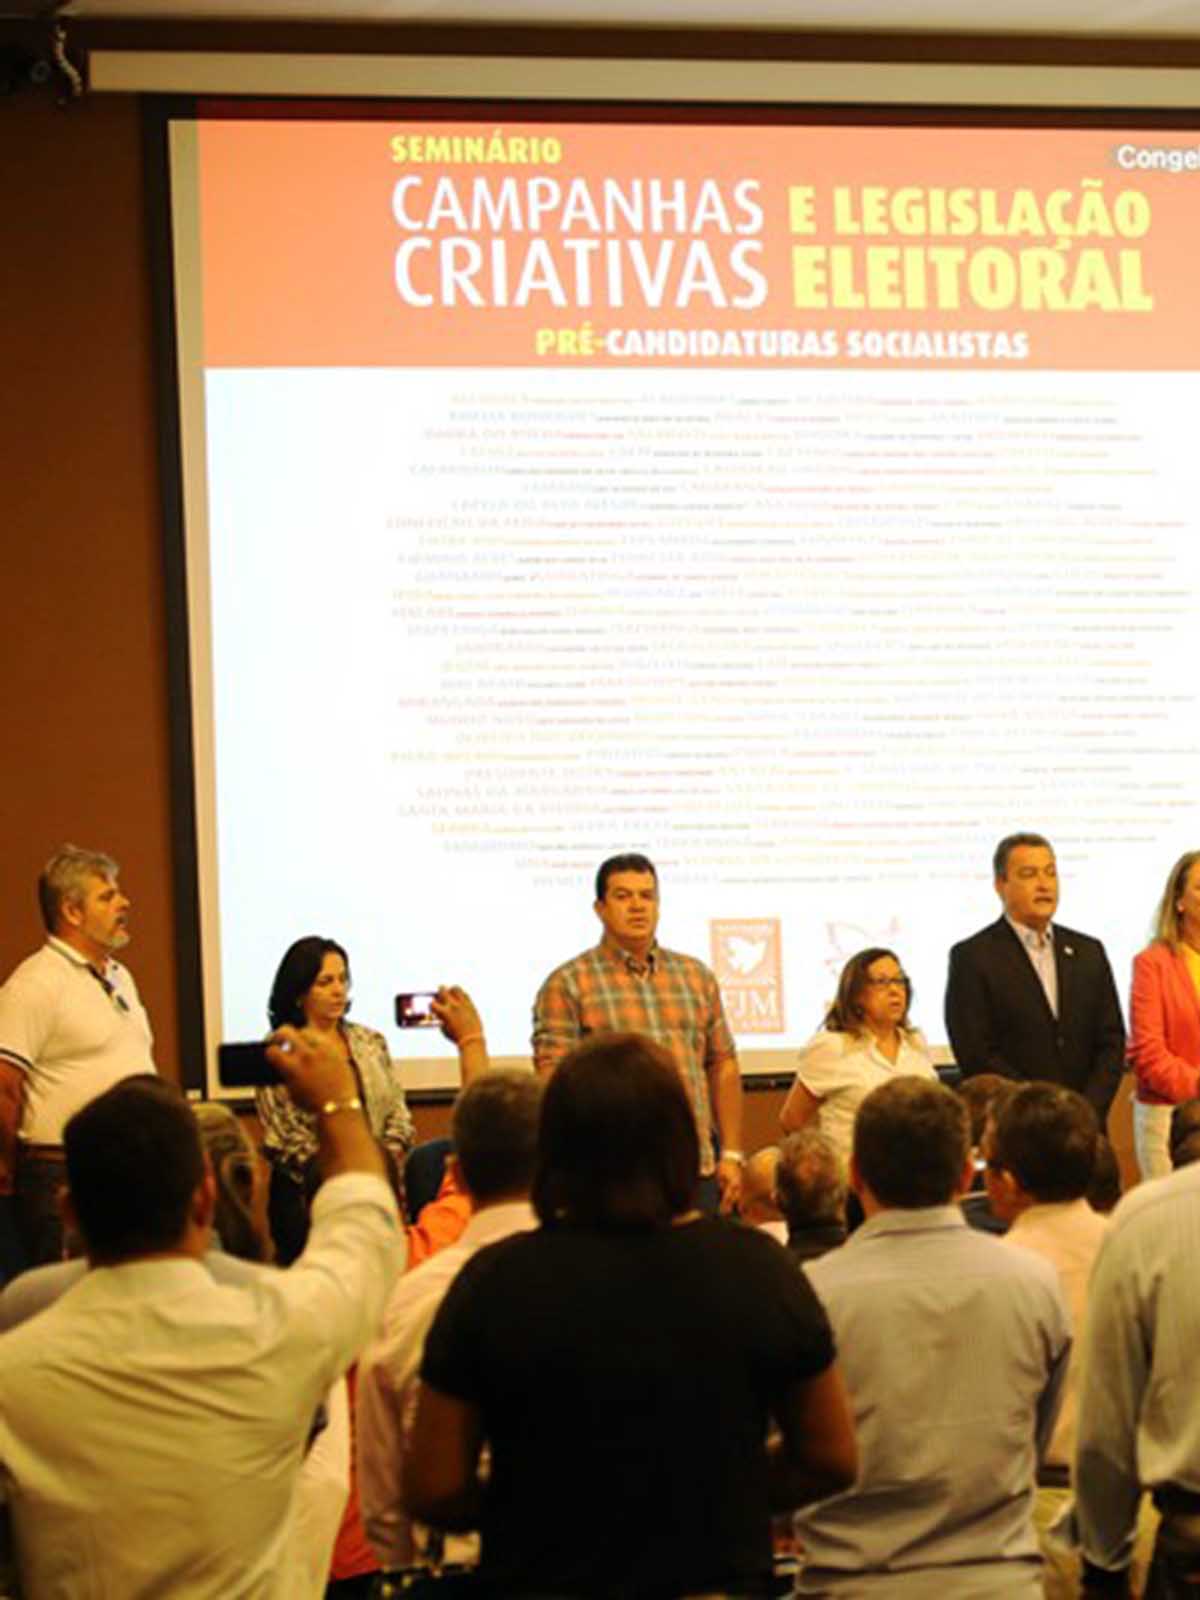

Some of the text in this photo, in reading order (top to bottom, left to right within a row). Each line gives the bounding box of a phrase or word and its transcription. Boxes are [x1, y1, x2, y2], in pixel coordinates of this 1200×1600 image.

[390, 128, 562, 164] SEMINÁRIO
[392, 176, 764, 232] CAMPANHAS
[789, 178, 1152, 247] E LEGISLAÇÃO
[394, 238, 768, 307] CRIATIVAS
[793, 248, 1154, 312] ELEITORAL
[846, 331, 1029, 359] SOCIALISTAS
